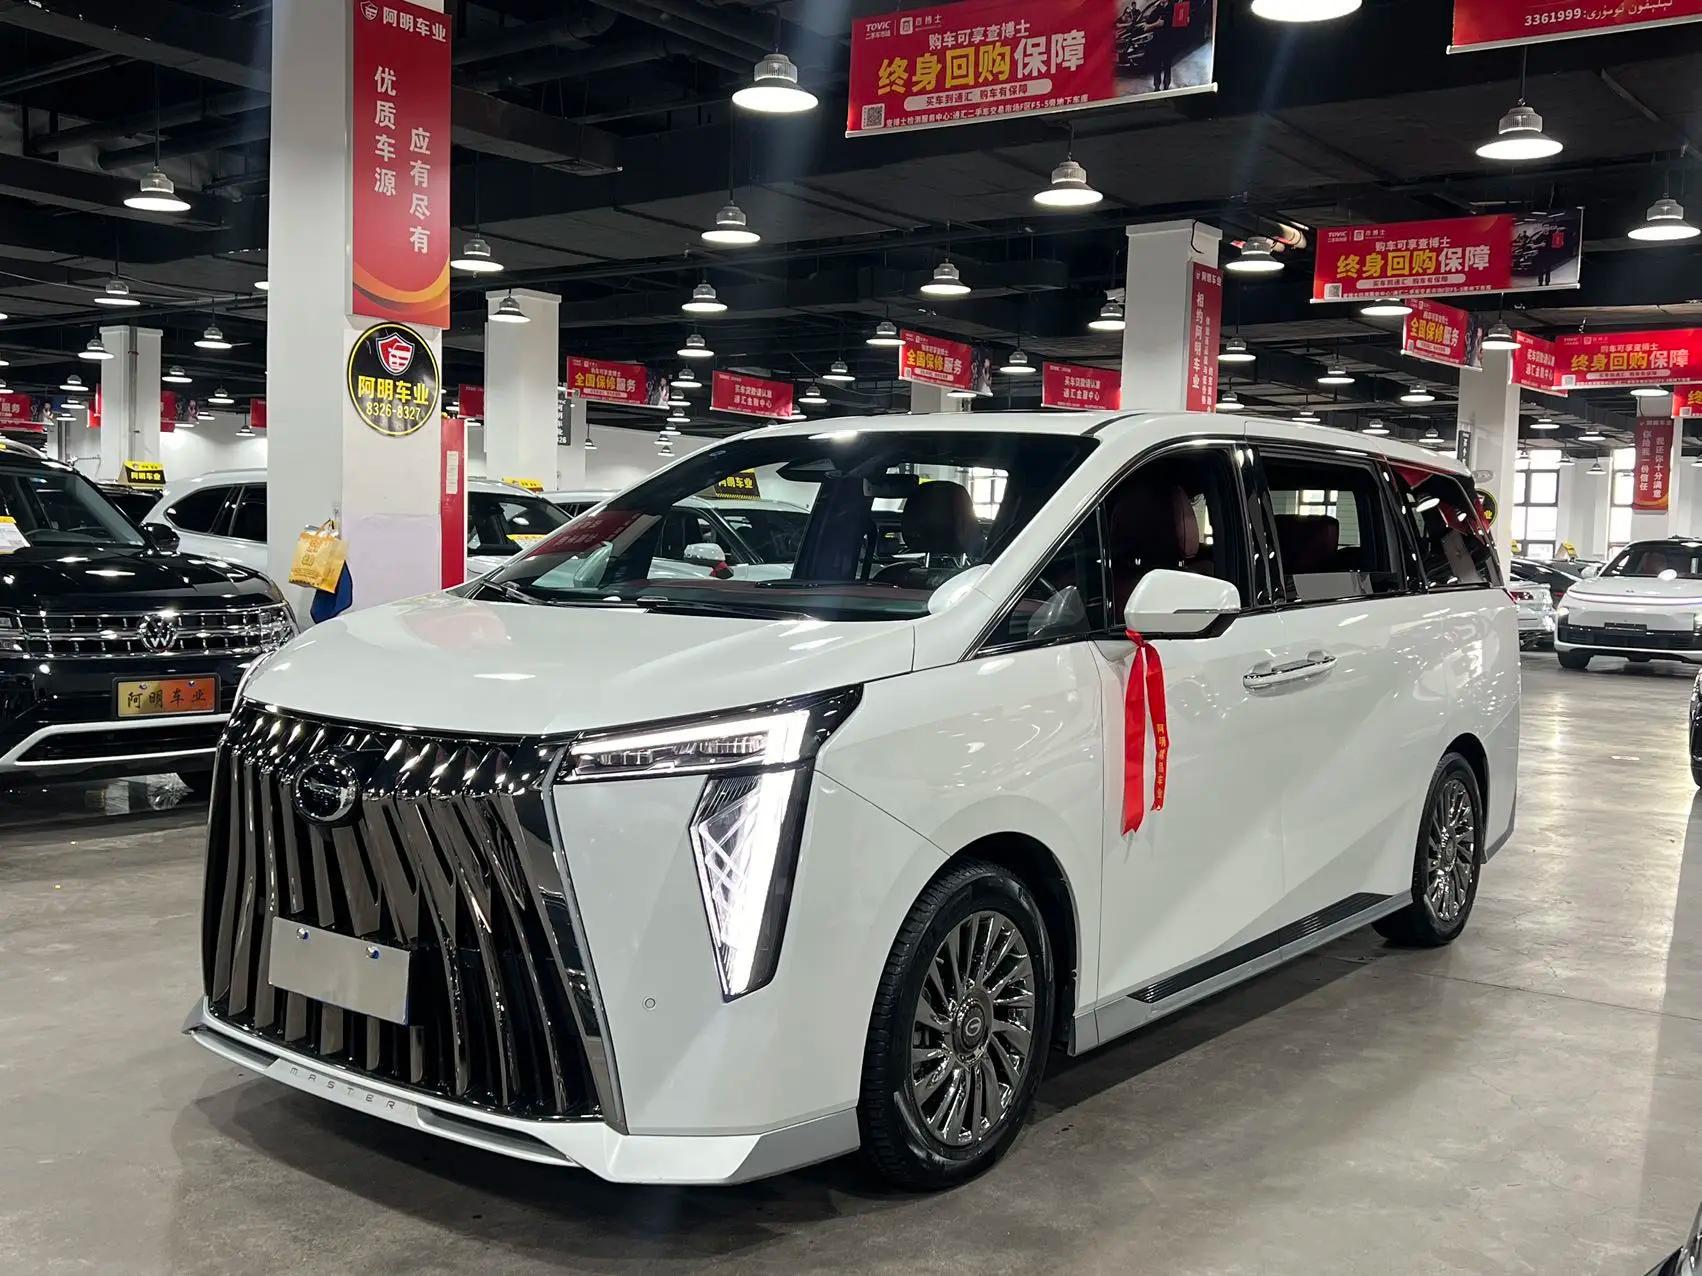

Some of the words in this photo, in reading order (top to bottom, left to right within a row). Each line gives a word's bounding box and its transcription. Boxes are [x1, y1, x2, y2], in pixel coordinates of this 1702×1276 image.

[383, 6, 446, 42] 阿明车业
[929, 20, 1030, 50] 购车可享查博士
[878, 29, 1086, 96] 终身回购保障
[926, 92, 974, 106] 买车到通汇
[979, 84, 1028, 100] 购车有保障
[374, 65, 397, 196] 优质车源
[409, 127, 431, 254] 应有尽有
[1336, 245, 1491, 279] 终身回购保障
[1410, 317, 1460, 347] 全国保修服务
[906, 349, 962, 375] 全国保修服务
[1571, 349, 1689, 372] 终身回购保障
[358, 375, 429, 405] 阿明车业
[575, 372, 636, 392] 全国保修服务
[366, 401, 421, 420] 8326-8327
[127, 689, 207, 709] 阿明车业
[289, 1066, 396, 1110] MASTER
